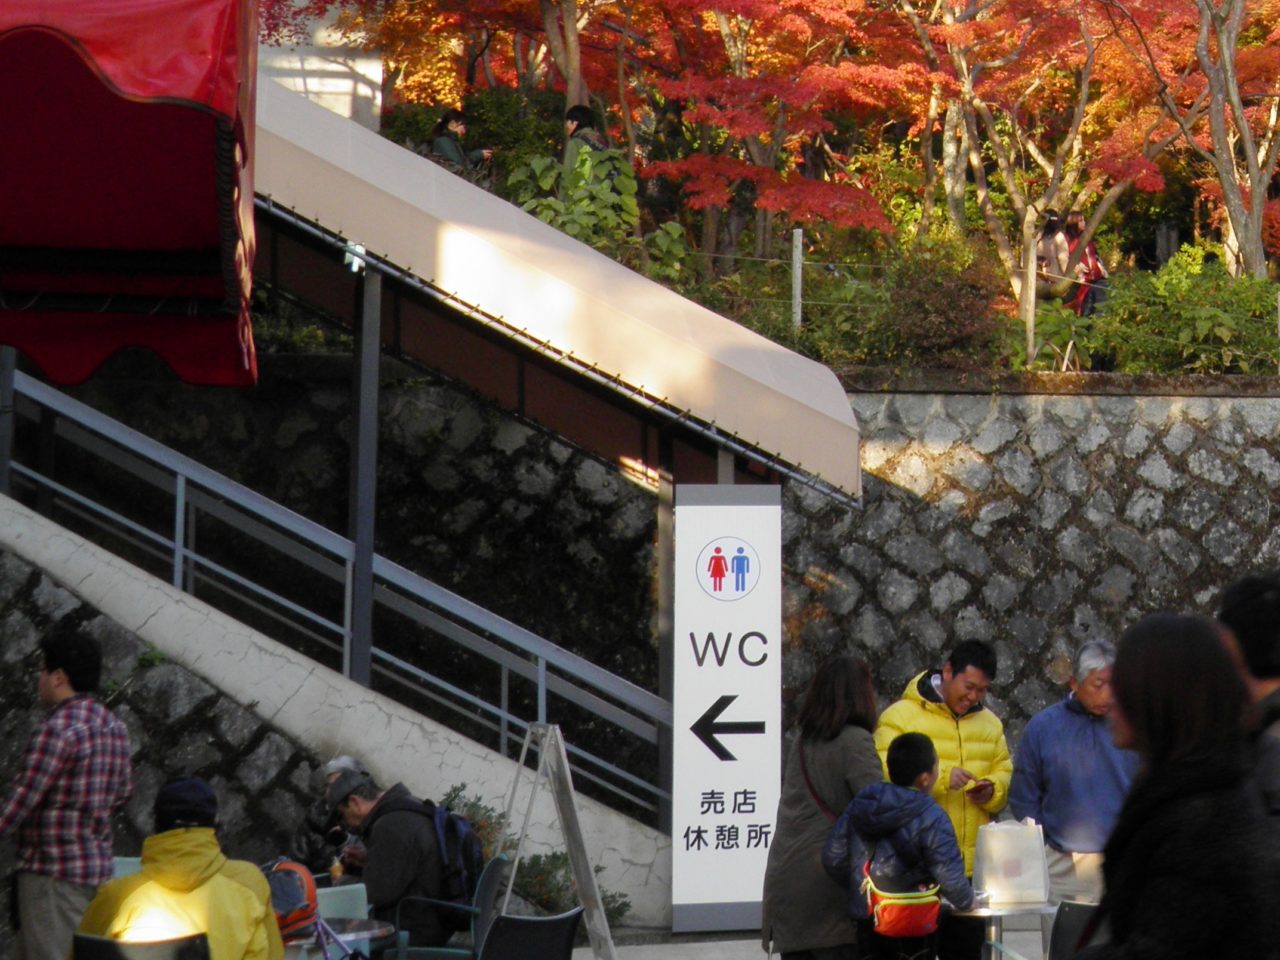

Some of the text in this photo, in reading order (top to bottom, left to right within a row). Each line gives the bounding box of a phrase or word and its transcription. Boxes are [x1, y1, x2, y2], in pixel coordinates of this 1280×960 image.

[689, 631, 769, 667] WC
[700, 788, 757, 815] 売店
[683, 823, 772, 852] 休憩所
